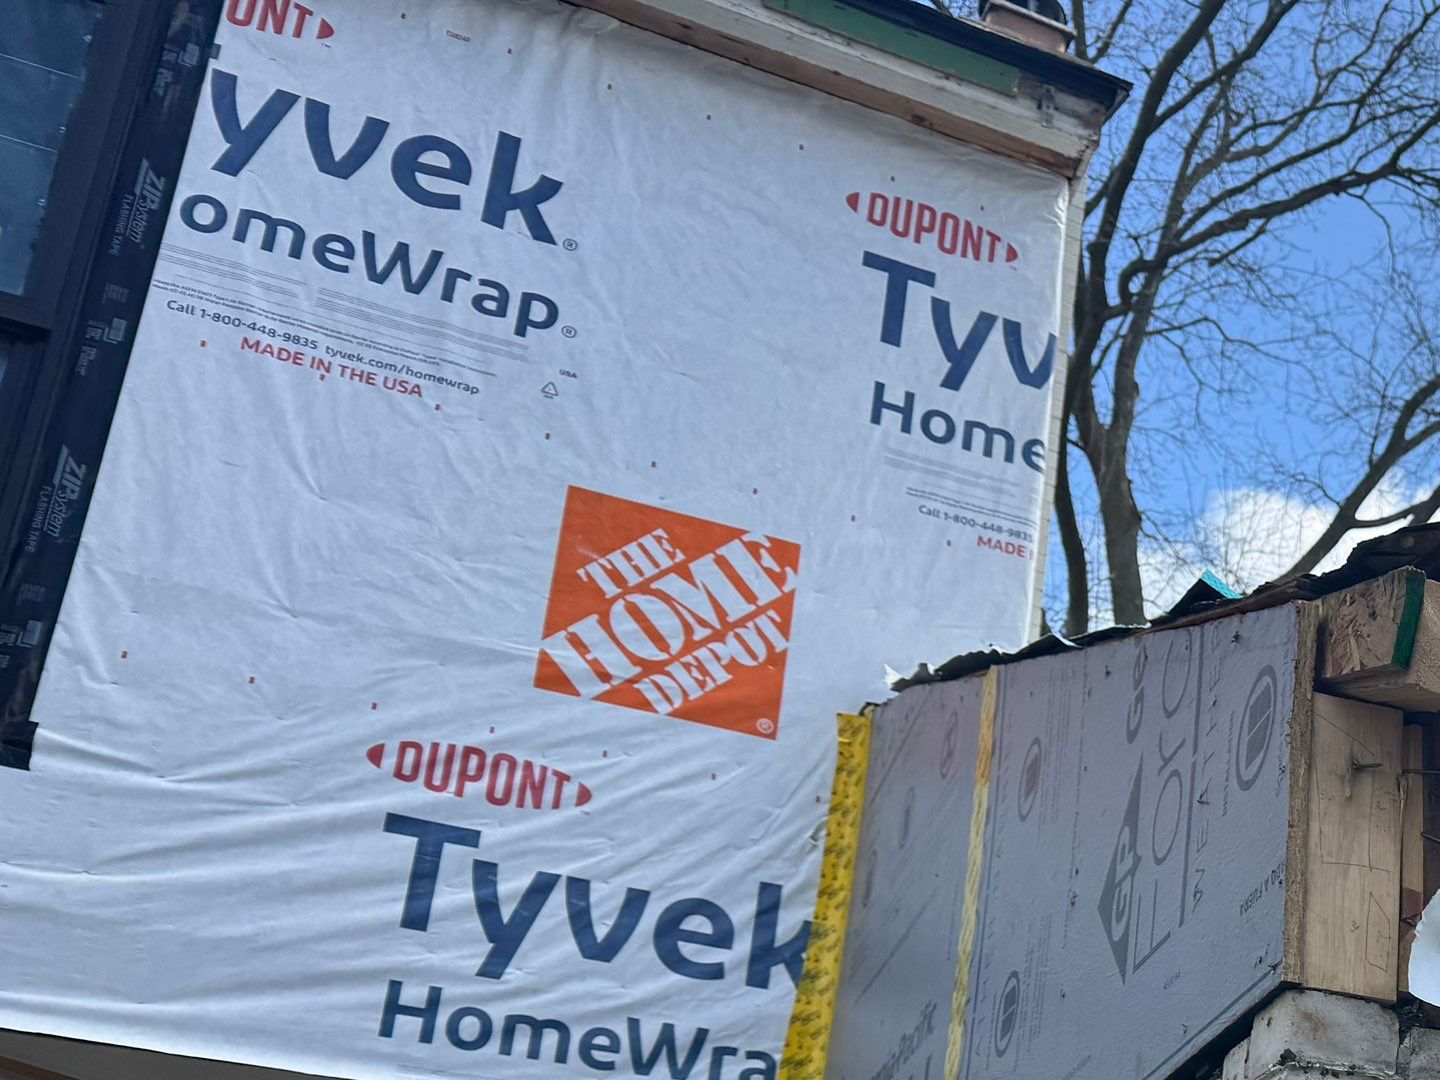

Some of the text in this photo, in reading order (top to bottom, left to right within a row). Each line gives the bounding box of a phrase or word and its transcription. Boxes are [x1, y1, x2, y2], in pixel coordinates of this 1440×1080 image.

[867, 191, 1002, 264] DUPONT
[179, 194, 560, 338] omeWrap
[167, 299, 196, 316] Call
[199, 309, 318, 350] 1-800-448-9835
[325, 345, 480, 396] tyvek.com/homewrap
[240, 336, 423, 399] MADE IN THE USA
[918, 504, 941, 519] Call
[977, 535, 1027, 558] MADE
[576, 528, 688, 600] THE
[541, 531, 798, 698] HOME
[632, 608, 791, 715] DEPOT
[391, 740, 572, 811] DUPONT
[383, 811, 814, 990] Tyvek
